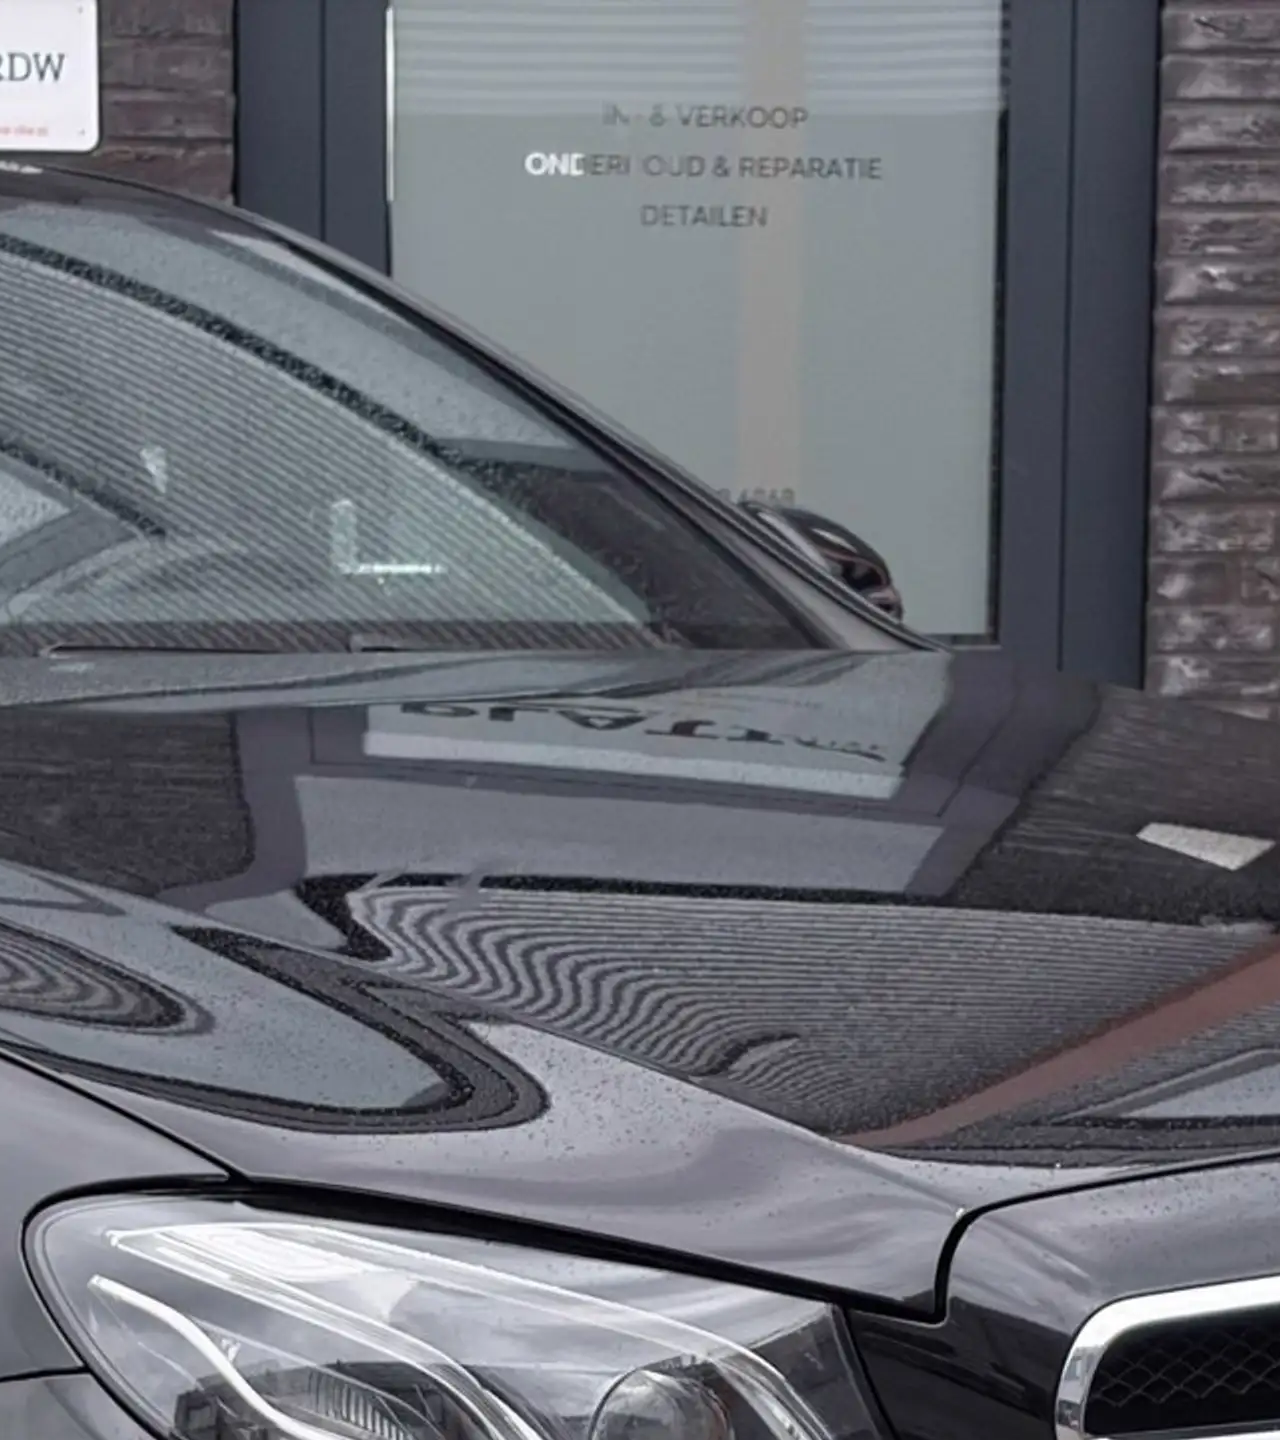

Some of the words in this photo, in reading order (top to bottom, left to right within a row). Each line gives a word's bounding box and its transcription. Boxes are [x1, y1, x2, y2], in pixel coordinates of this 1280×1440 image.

[677, 104, 809, 130] VERKOOP
[712, 155, 732, 178] &
[738, 156, 882, 180] REPARATIE
[640, 204, 768, 228] DETAILEN
